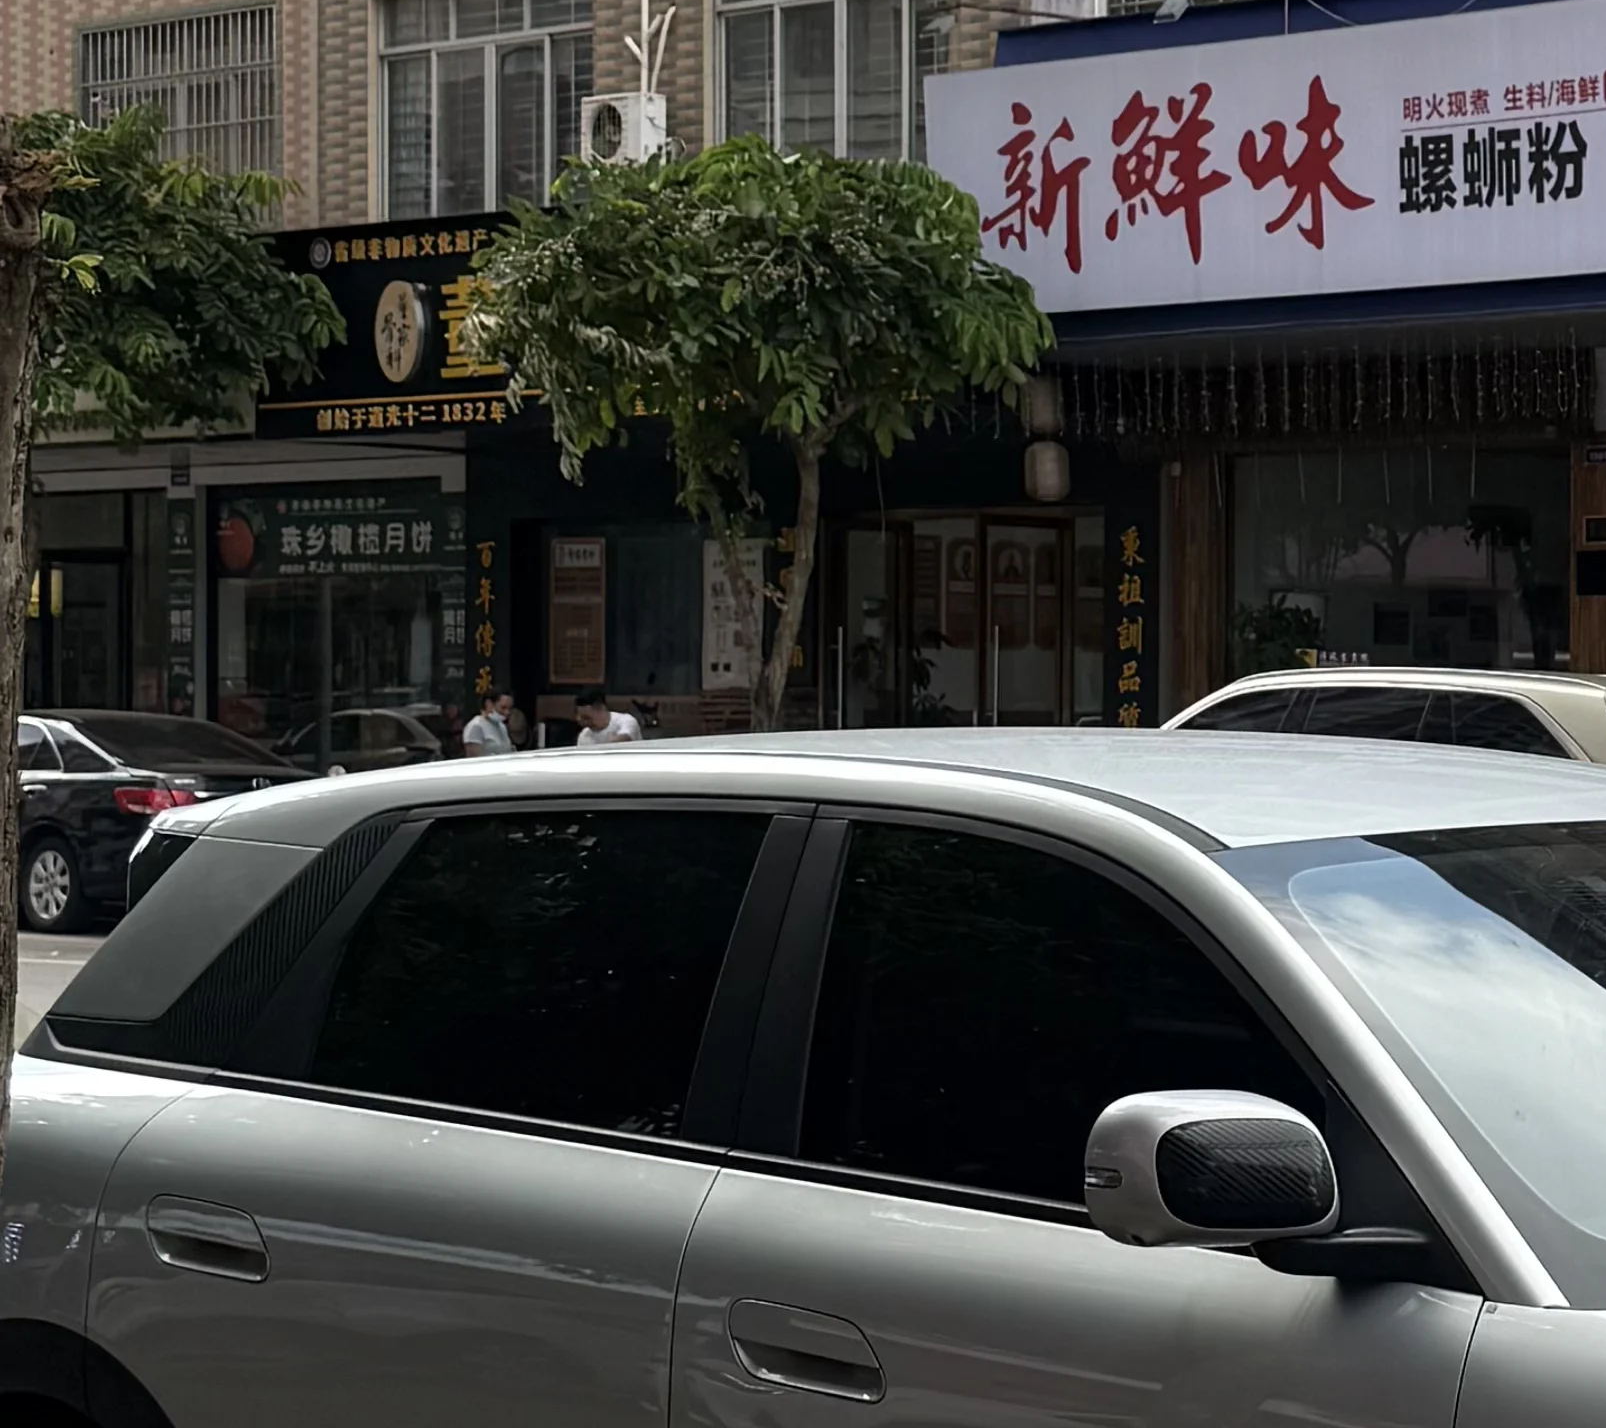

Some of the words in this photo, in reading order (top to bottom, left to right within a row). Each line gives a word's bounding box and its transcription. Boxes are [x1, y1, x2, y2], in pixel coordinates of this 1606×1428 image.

[1401, 88, 1491, 122] 明火现煮
[1502, 74, 1600, 113] 生料/海鲜
[980, 74, 1377, 274] 新鲜味
[1399, 119, 1588, 214] 螺蛳粉
[441, 401, 487, 423] 1832
